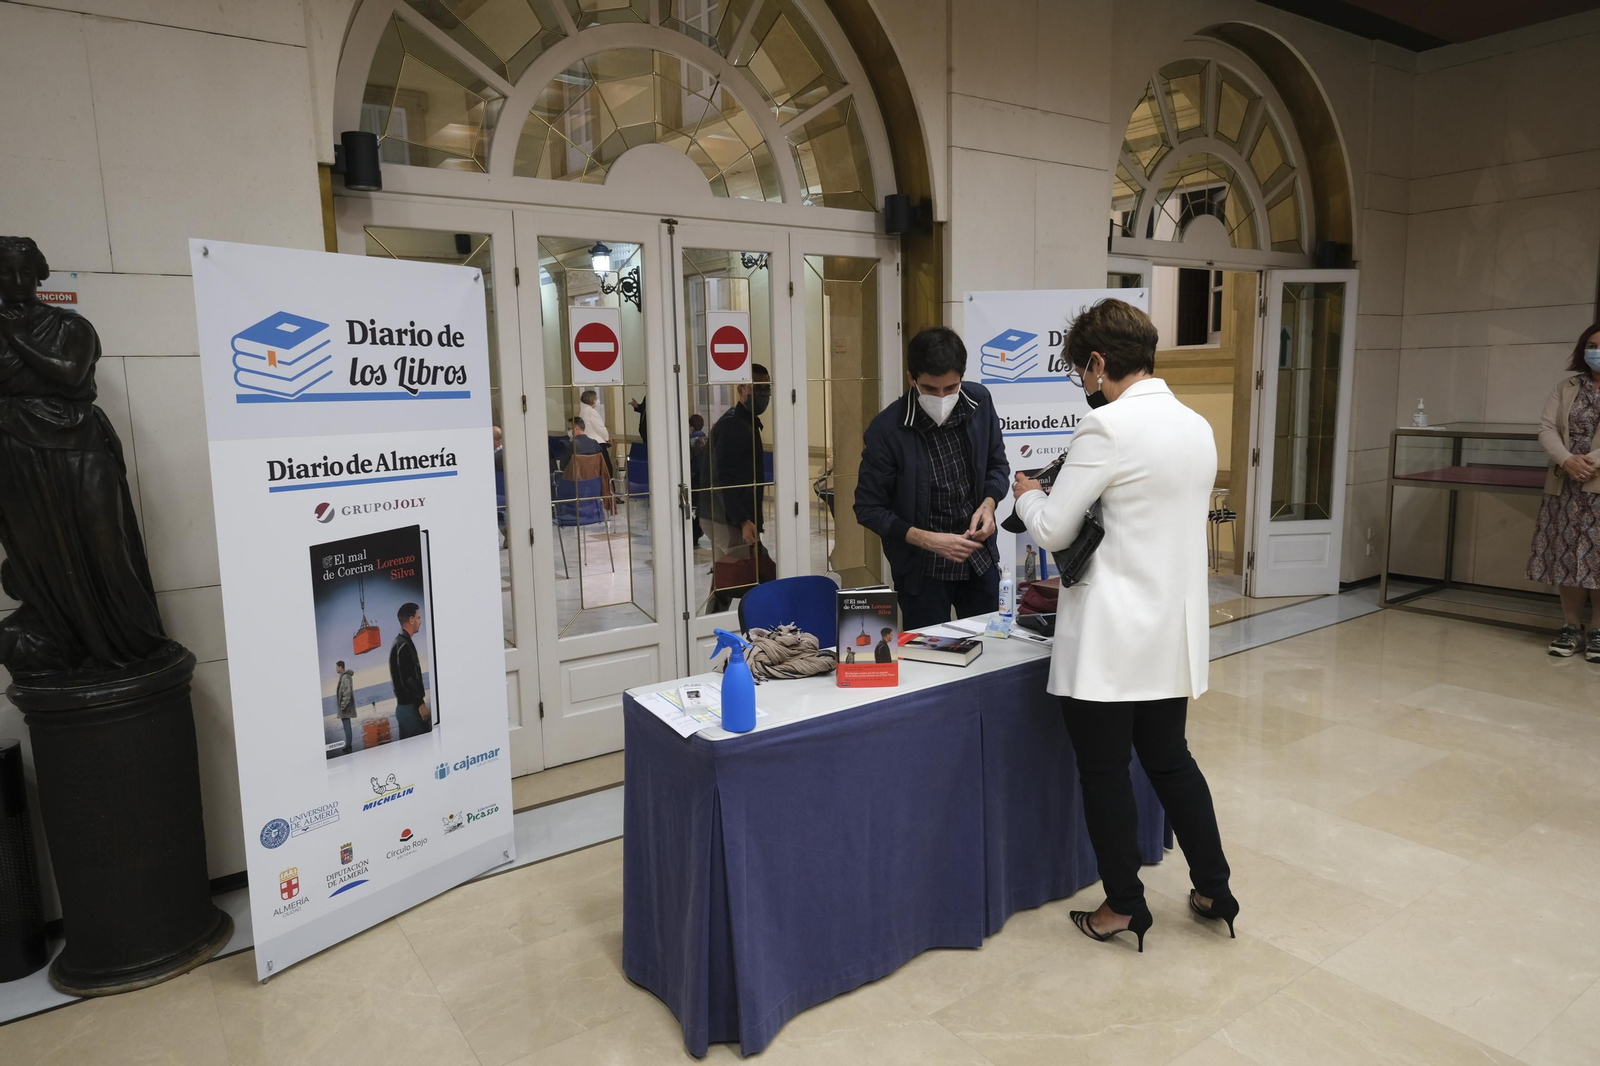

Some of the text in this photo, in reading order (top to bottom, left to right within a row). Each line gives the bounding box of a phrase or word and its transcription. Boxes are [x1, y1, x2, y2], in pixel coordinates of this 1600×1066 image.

[36, 292, 72, 301] ENCIÓN
[346, 318, 464, 348] Diario de
[349, 356, 467, 396] los Libros
[1041, 415, 1058, 428] de
[1036, 446, 1070, 454] GRUPO
[266, 446, 458, 482] Diario de Almería
[334, 549, 368, 566] El mal
[376, 554, 416, 570] Lorenzo
[322, 562, 374, 581] de Corcira
[390, 568, 415, 580] Silva
[453, 748, 500, 771] cajamar
[362, 786, 414, 812] MICHELIN
[289, 800, 339, 823] UNIVERSIDAD
[290, 808, 340, 831] DE ALMERÍA
[466, 806, 499, 824] Picasso
[412, 838, 428, 848] Rojo
[326, 859, 370, 882] DIPUTACIÓN
[327, 866, 369, 889] DE ALMERÍA
[273, 896, 310, 917] ALMERÍA
